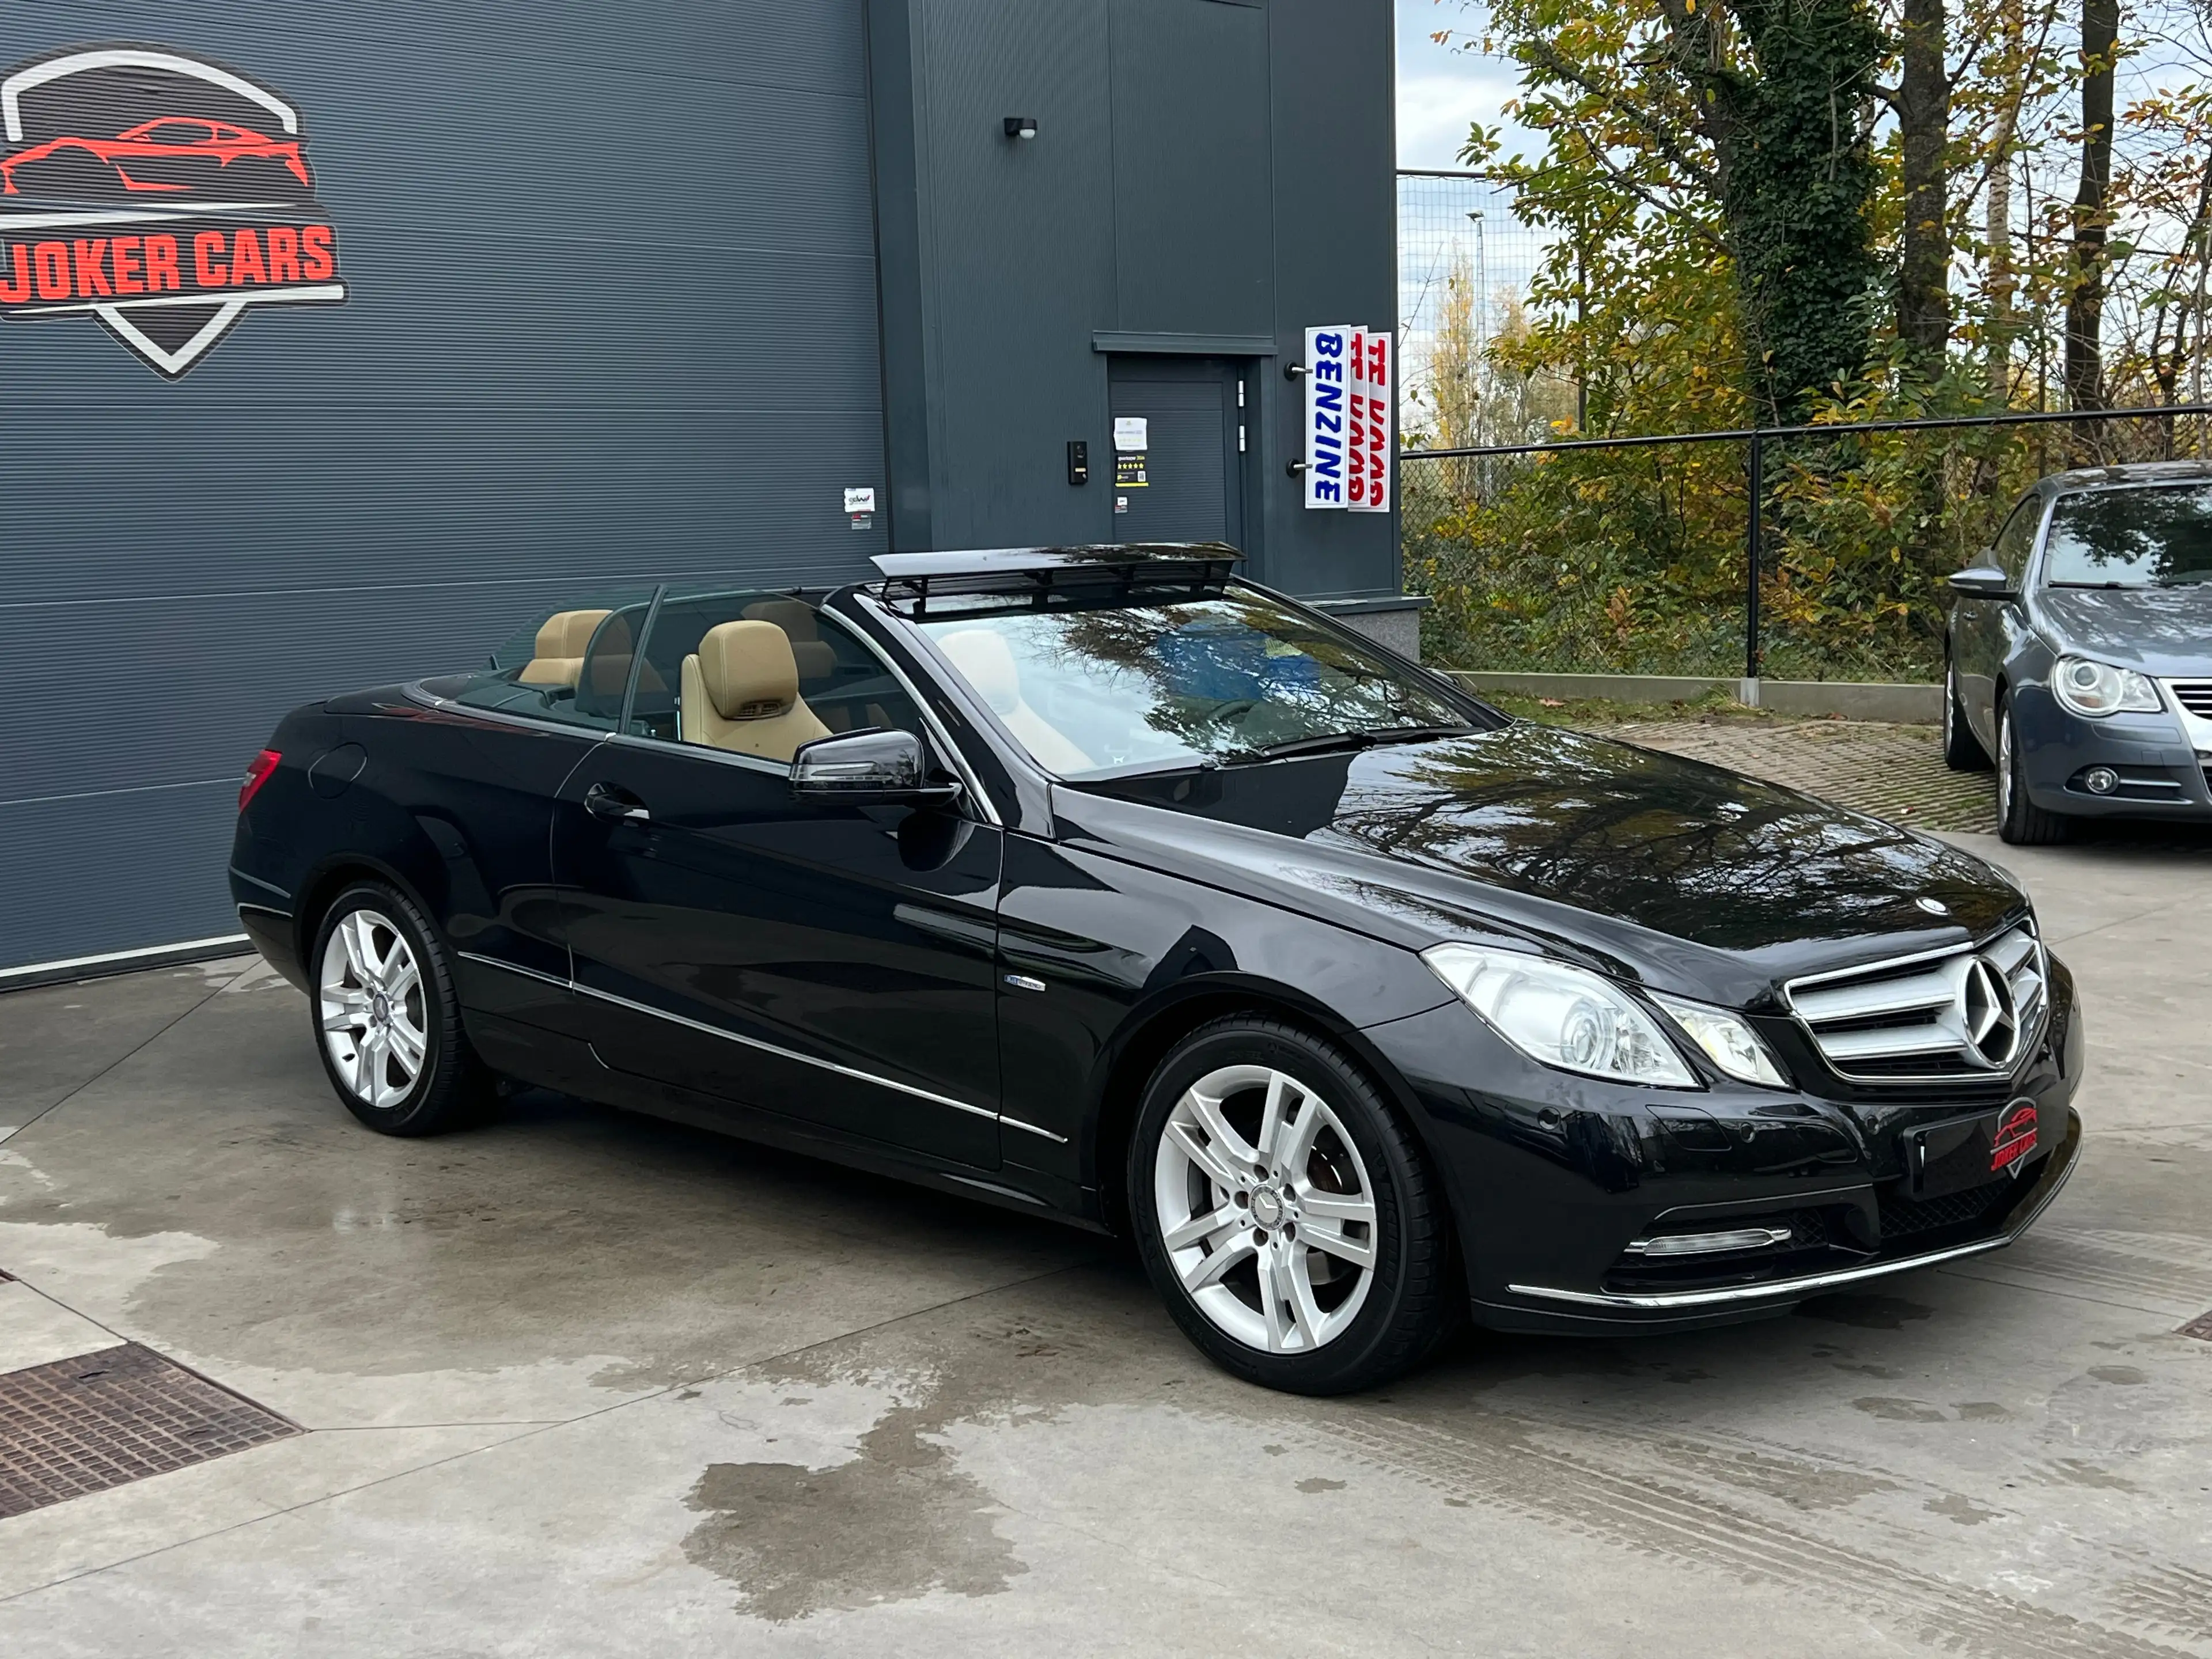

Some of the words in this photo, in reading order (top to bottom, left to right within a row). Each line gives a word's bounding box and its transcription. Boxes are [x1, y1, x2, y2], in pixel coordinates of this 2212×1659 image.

[0, 234, 180, 303] JOKER
[194, 225, 333, 287] CARS
[1315, 332, 1343, 503] BENZINE
